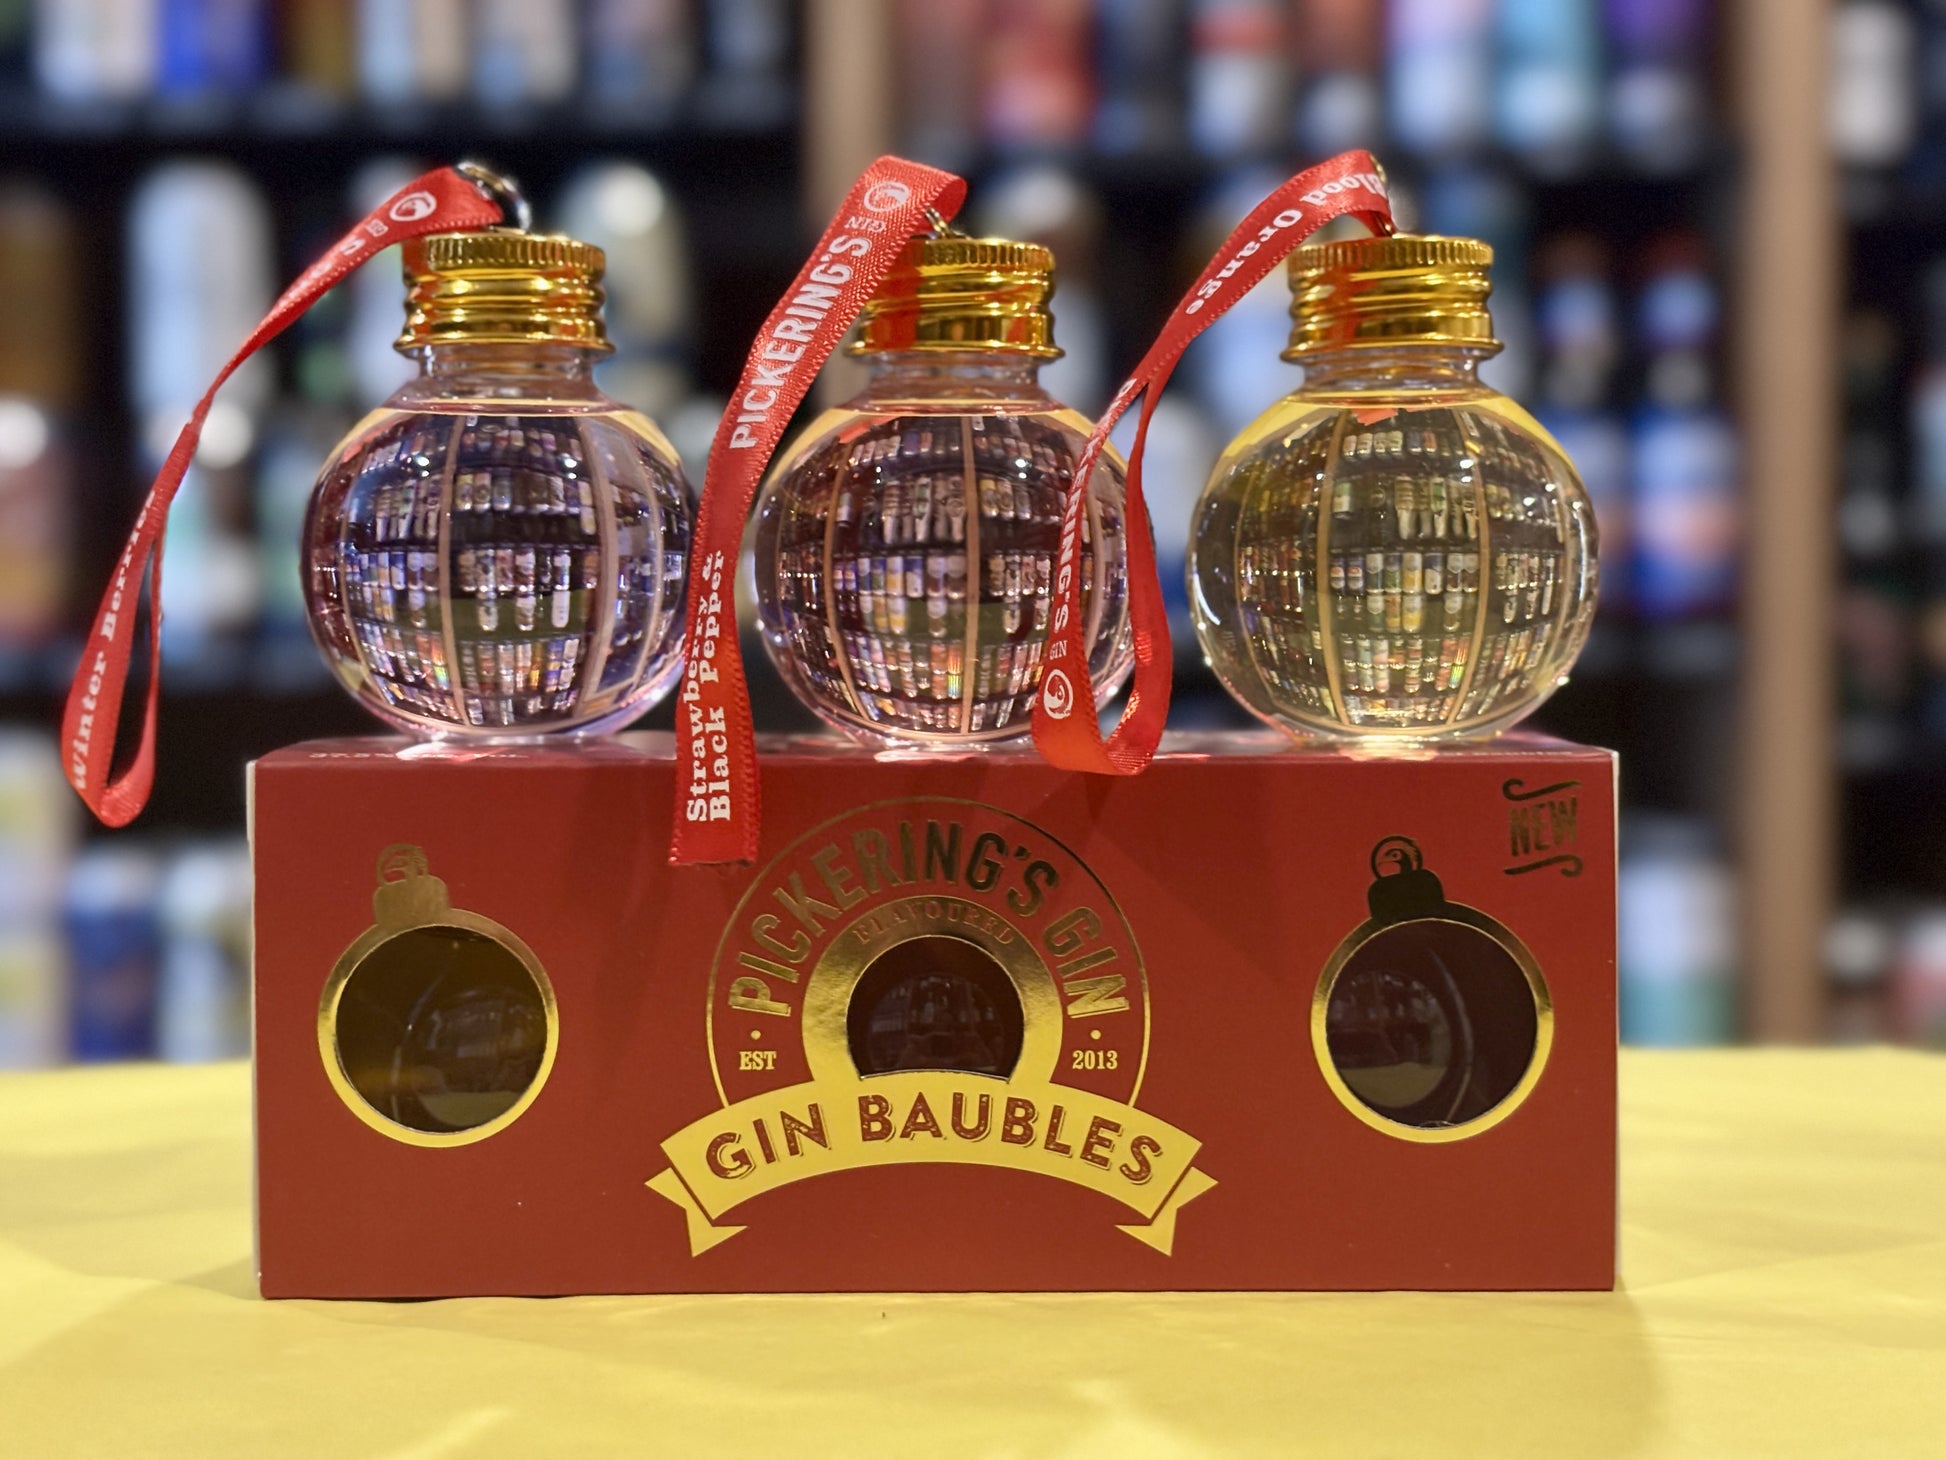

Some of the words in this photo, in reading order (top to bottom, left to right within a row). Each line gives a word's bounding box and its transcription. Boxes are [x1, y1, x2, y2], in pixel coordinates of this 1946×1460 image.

[1185, 208, 1303, 315] Orange
[729, 235, 873, 449] PICKERING'S
[844, 214, 887, 233] GIN
[1053, 378, 1138, 634] PKERING'S
[699, 549, 725, 684] Pepper
[1049, 638, 1068, 661] GIN
[72, 651, 107, 790] Winter
[686, 595, 709, 822] Strawberry
[704, 705, 731, 822] Black
[1509, 796, 1578, 857] NEW
[728, 818, 1060, 1018] PICKERING'S
[1041, 906, 1131, 1019] GIN
[738, 1050, 777, 1071] EST
[1071, 1050, 1119, 1071] 2013
[705, 1102, 832, 1181] GIN
[857, 1090, 1164, 1185] BAUBLES
